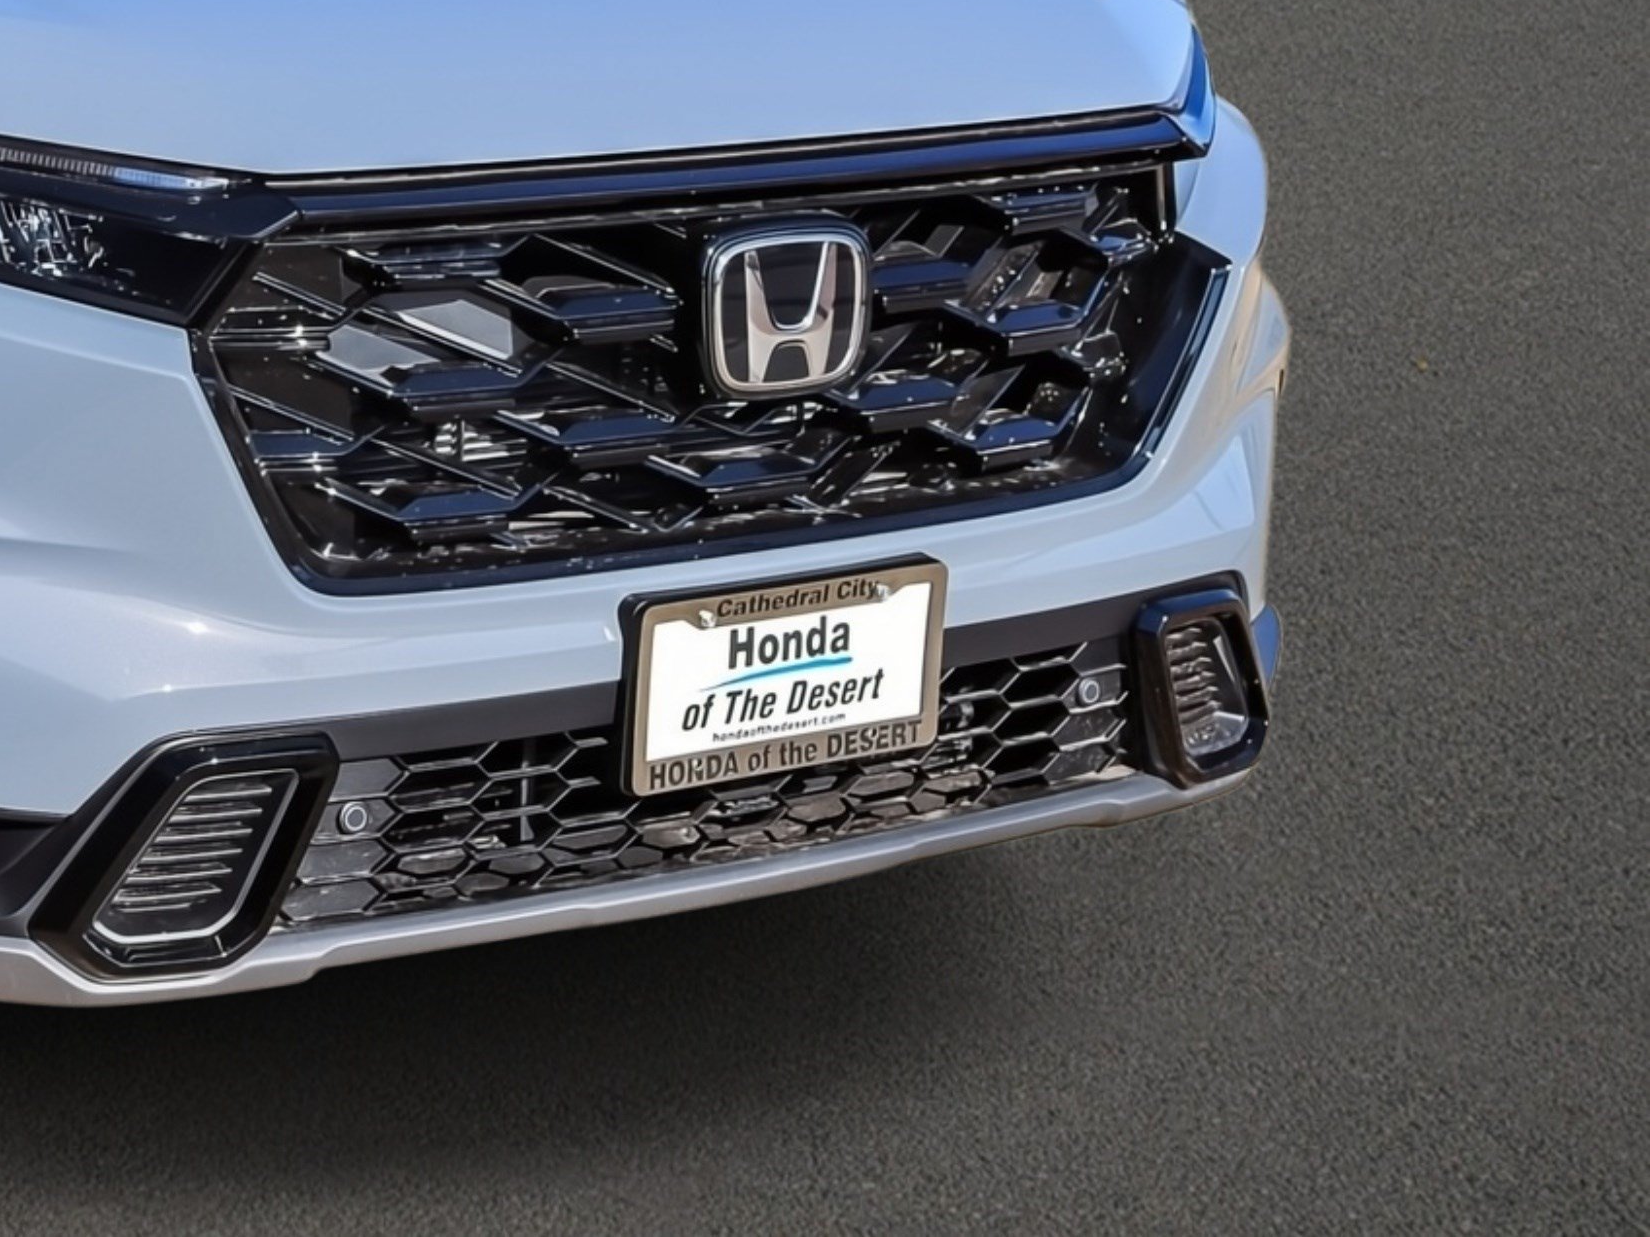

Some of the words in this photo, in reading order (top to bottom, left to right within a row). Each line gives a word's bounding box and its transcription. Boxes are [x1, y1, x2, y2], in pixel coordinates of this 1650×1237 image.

[716, 583, 830, 618] Cathedral
[836, 577, 880, 601] City
[728, 615, 850, 670] Honda
[681, 693, 717, 732] of
[724, 685, 777, 726] The
[786, 668, 884, 714] Desert
[711, 712, 847, 743] hondaofthedesert.com
[649, 751, 740, 791] HONDA
[747, 744, 775, 773] of
[777, 739, 818, 766] the
[826, 719, 923, 752] DESERT
